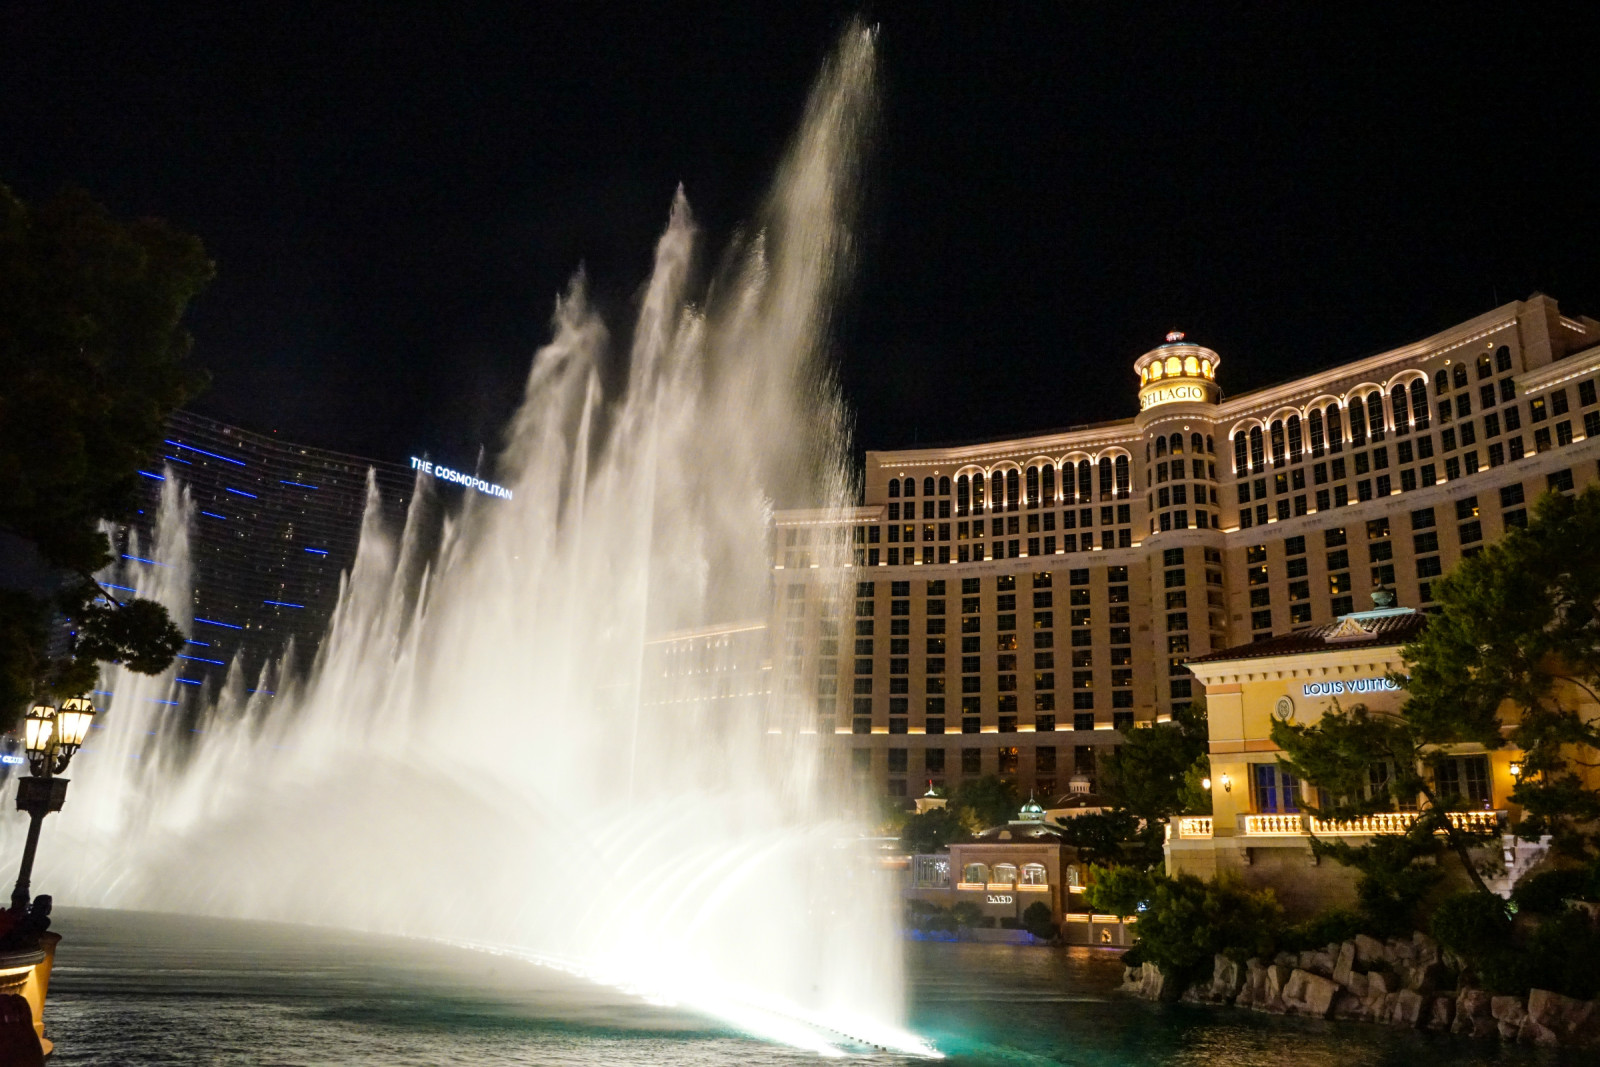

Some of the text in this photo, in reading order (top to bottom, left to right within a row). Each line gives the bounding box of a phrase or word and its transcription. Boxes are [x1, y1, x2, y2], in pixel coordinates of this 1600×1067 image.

[1141, 386, 1203, 408] BELLAGIO
[410, 456, 513, 500] THE COSMOPOLITAN
[1303, 677, 1408, 696] LOUIS VUITTO
